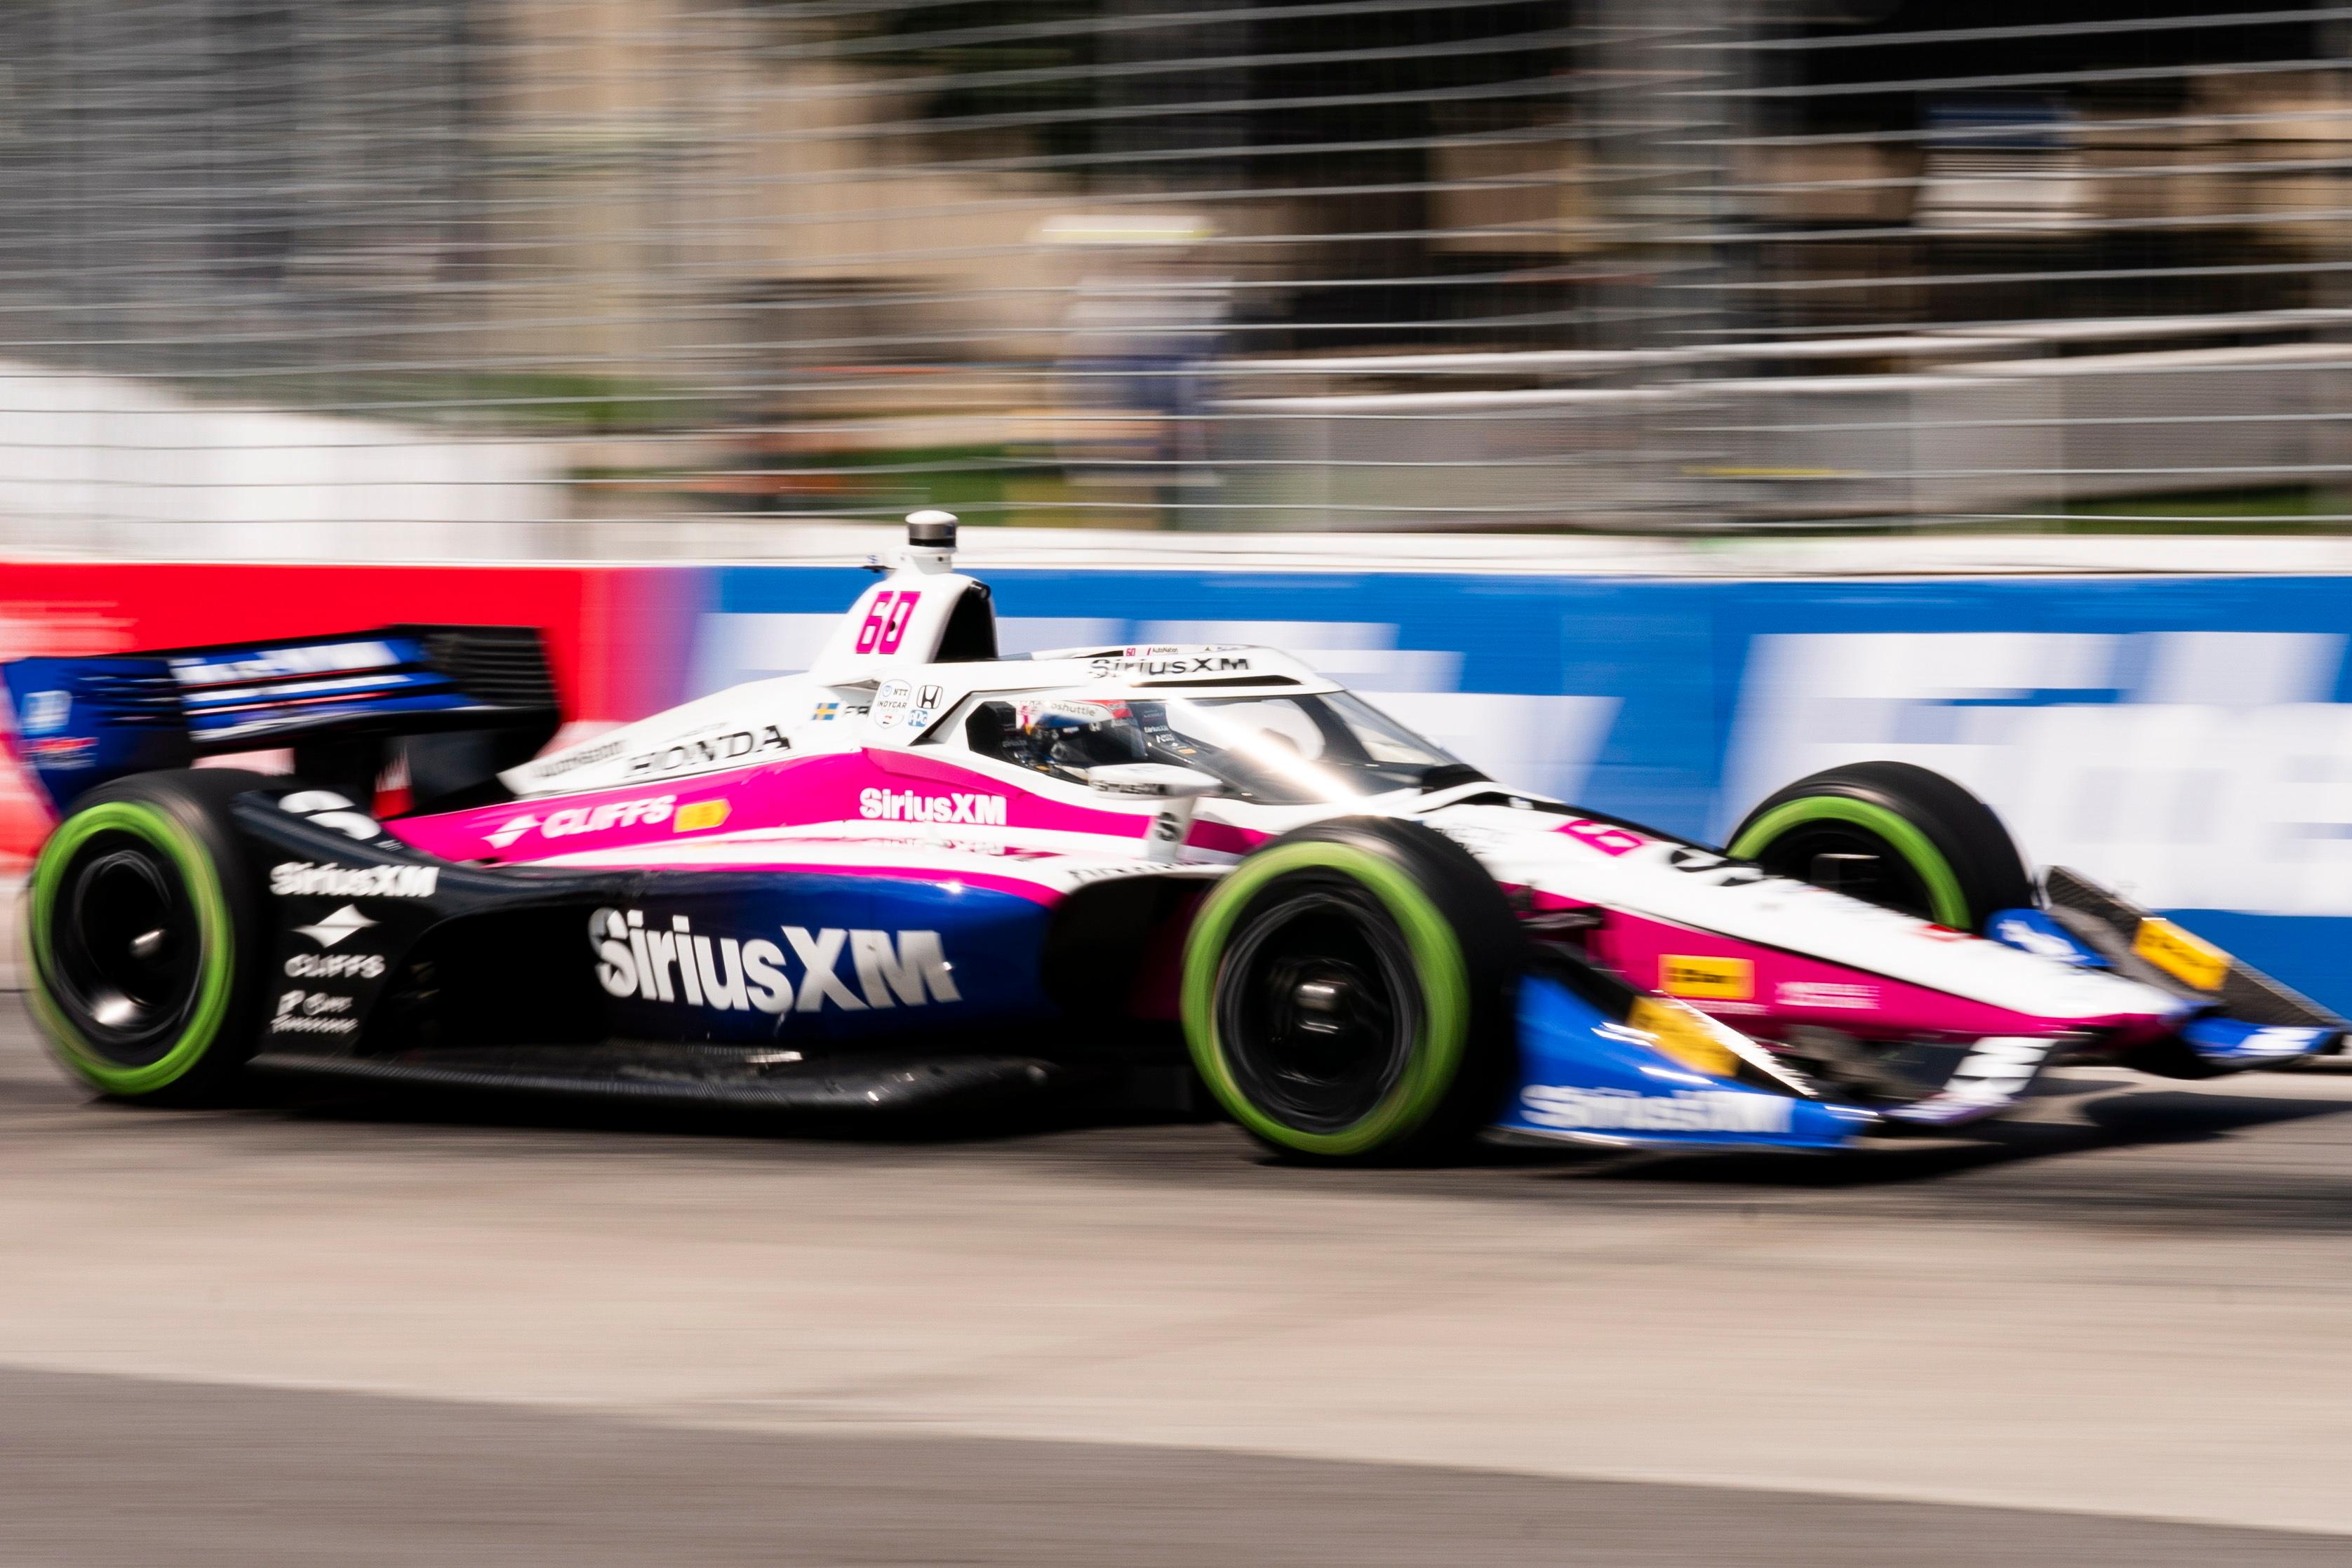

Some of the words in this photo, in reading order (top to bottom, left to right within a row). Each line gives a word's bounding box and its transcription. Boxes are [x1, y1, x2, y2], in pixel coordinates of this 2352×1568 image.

[855, 591, 921, 655] 60
[1088, 657, 1250, 679] SiriusXM
[1125, 648, 1136, 657] 60
[877, 701, 907, 709] INDYCAR
[893, 688, 909, 697] NTT
[909, 711, 928, 727] PPG
[627, 724, 793, 779] HONDA
[540, 794, 678, 838] CLIFFS
[859, 787, 1007, 826] SiriusXM
[269, 862, 440, 898] SiriusXM
[283, 953, 386, 979] CLIFFS
[587, 907, 964, 1014] SiriusXM
